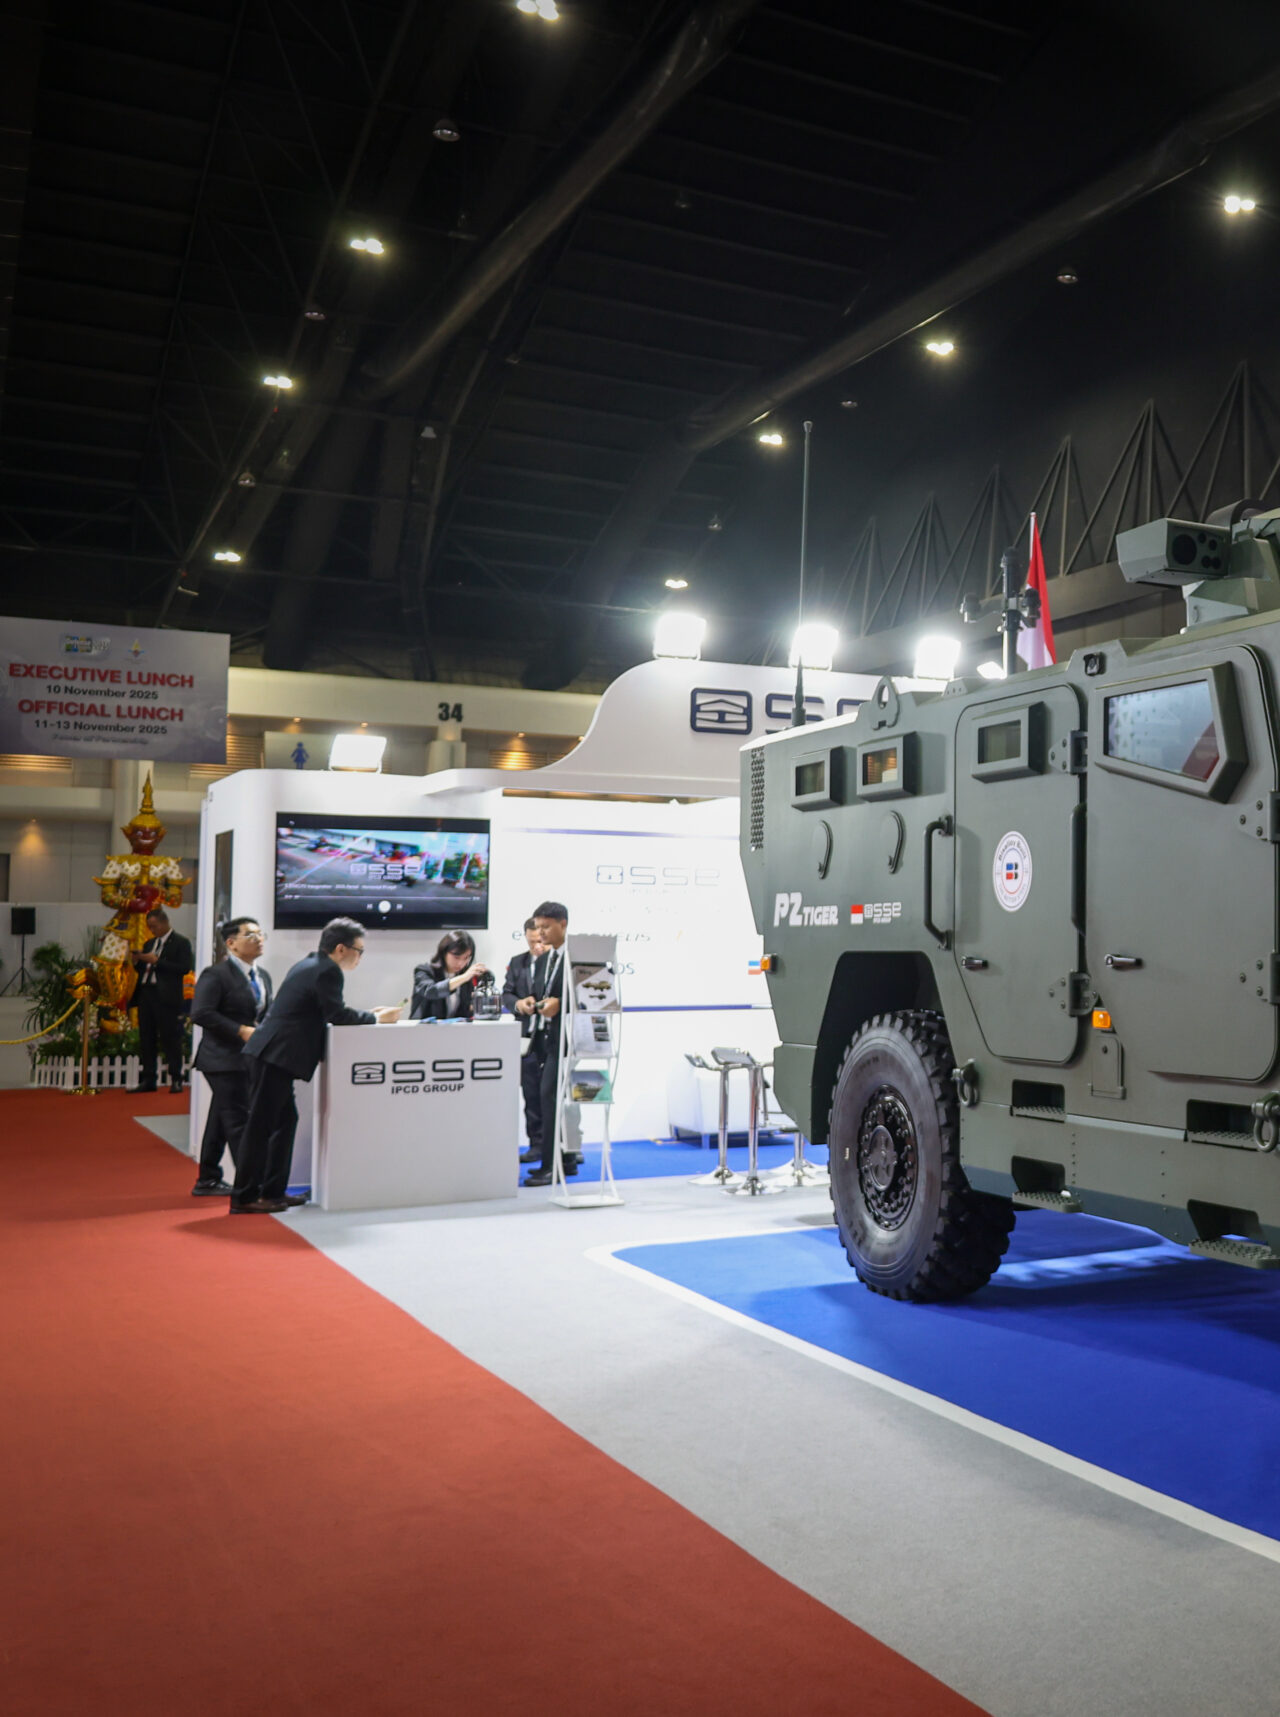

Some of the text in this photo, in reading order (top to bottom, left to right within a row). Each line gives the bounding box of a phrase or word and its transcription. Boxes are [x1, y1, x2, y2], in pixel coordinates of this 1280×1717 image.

[9, 663, 195, 688] EXECUTIVE LUNCH
[46, 685, 159, 700] 10 November 2025
[18, 699, 184, 721] OFFICIAL LUNCH
[438, 702, 463, 723] 34
[34, 719, 167, 735] 11-13 November 2025
[803, 905, 839, 926] TIGER
[391, 1083, 465, 1095] IPCD GROUP
